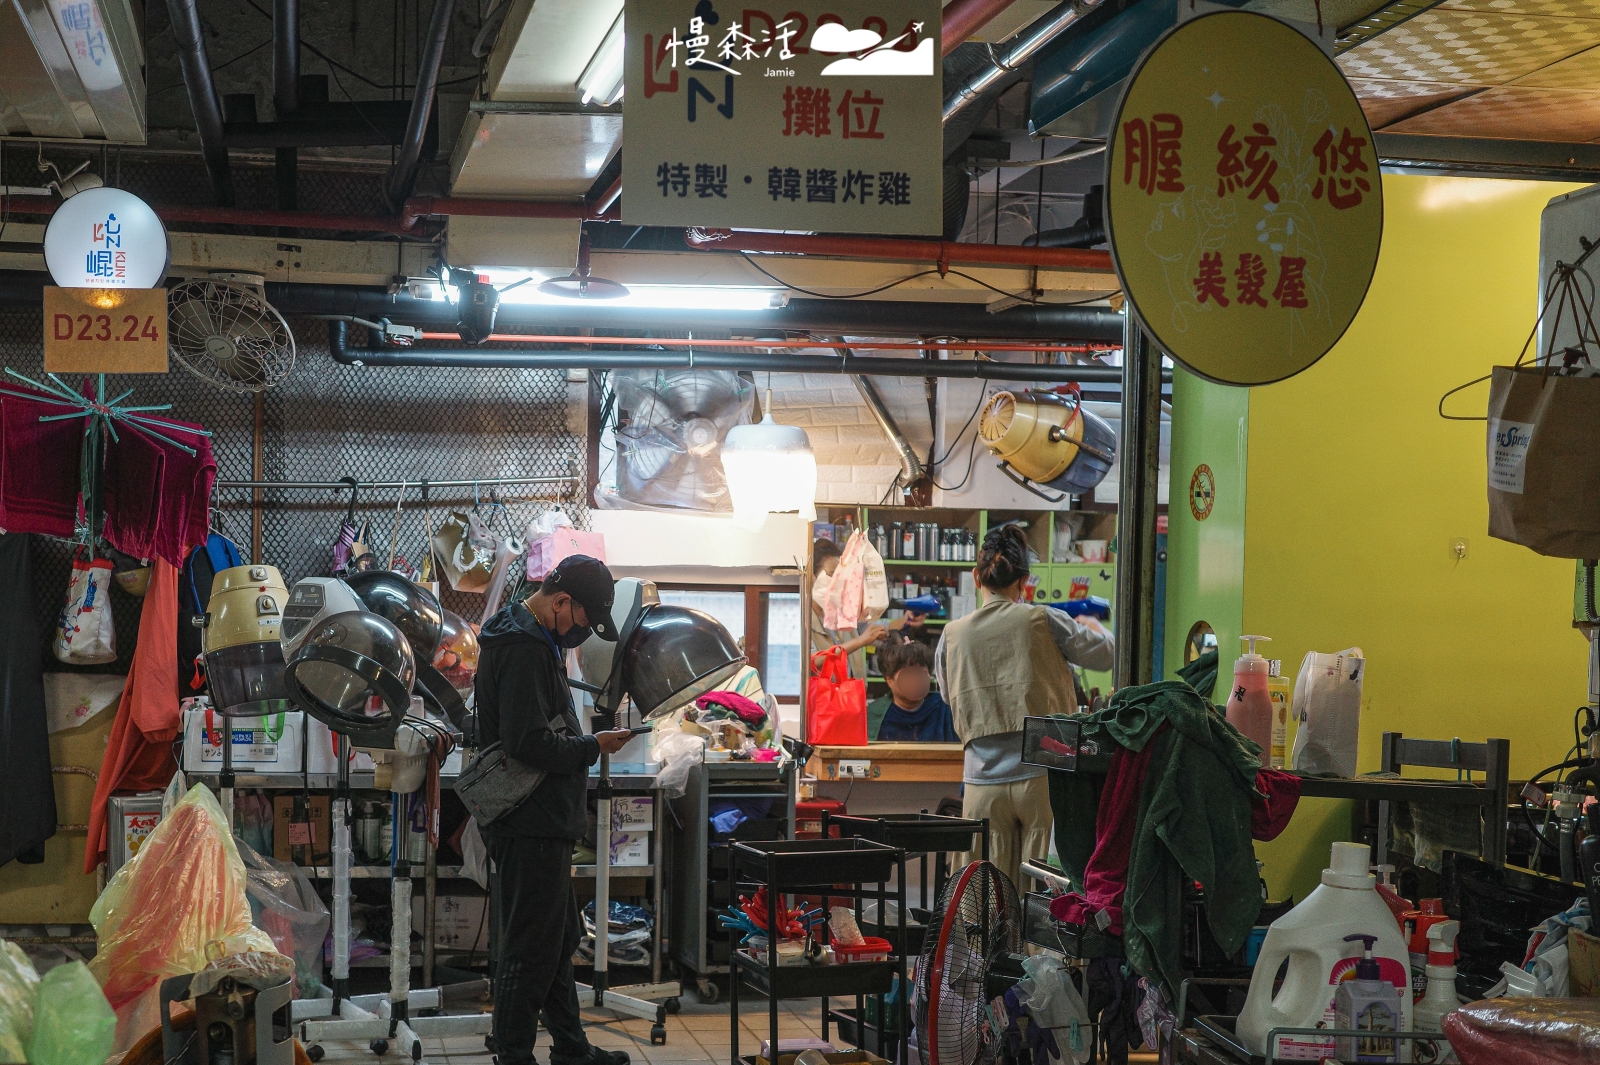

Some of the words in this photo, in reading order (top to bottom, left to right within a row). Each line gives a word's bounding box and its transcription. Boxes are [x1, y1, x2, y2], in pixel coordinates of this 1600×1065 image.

[782, 85, 884, 139] 攤位
[115, 251, 126, 278] KUN
[1193, 251, 1308, 308] 美髮屋
[53, 313, 159, 342] D23.24
